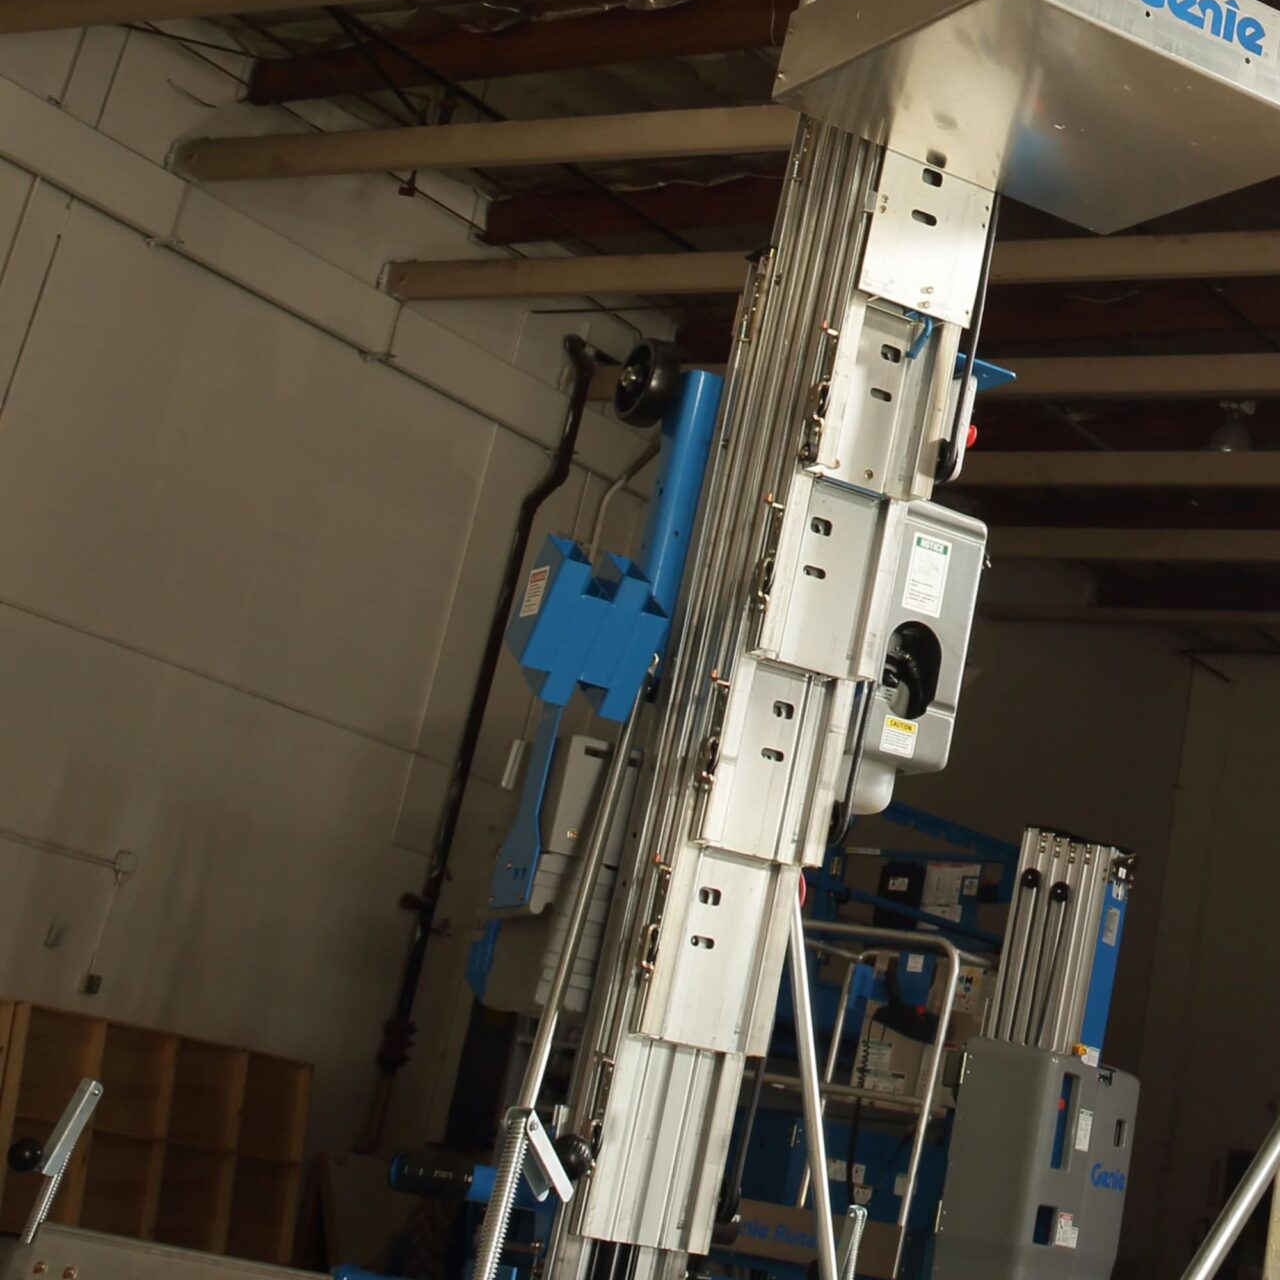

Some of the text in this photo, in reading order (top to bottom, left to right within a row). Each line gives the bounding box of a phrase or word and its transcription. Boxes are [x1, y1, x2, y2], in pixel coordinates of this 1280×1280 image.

[921, 537, 944, 554] NOTICE
[889, 719, 912, 731] CAUTION
[1090, 1161, 1126, 1192] Genie
